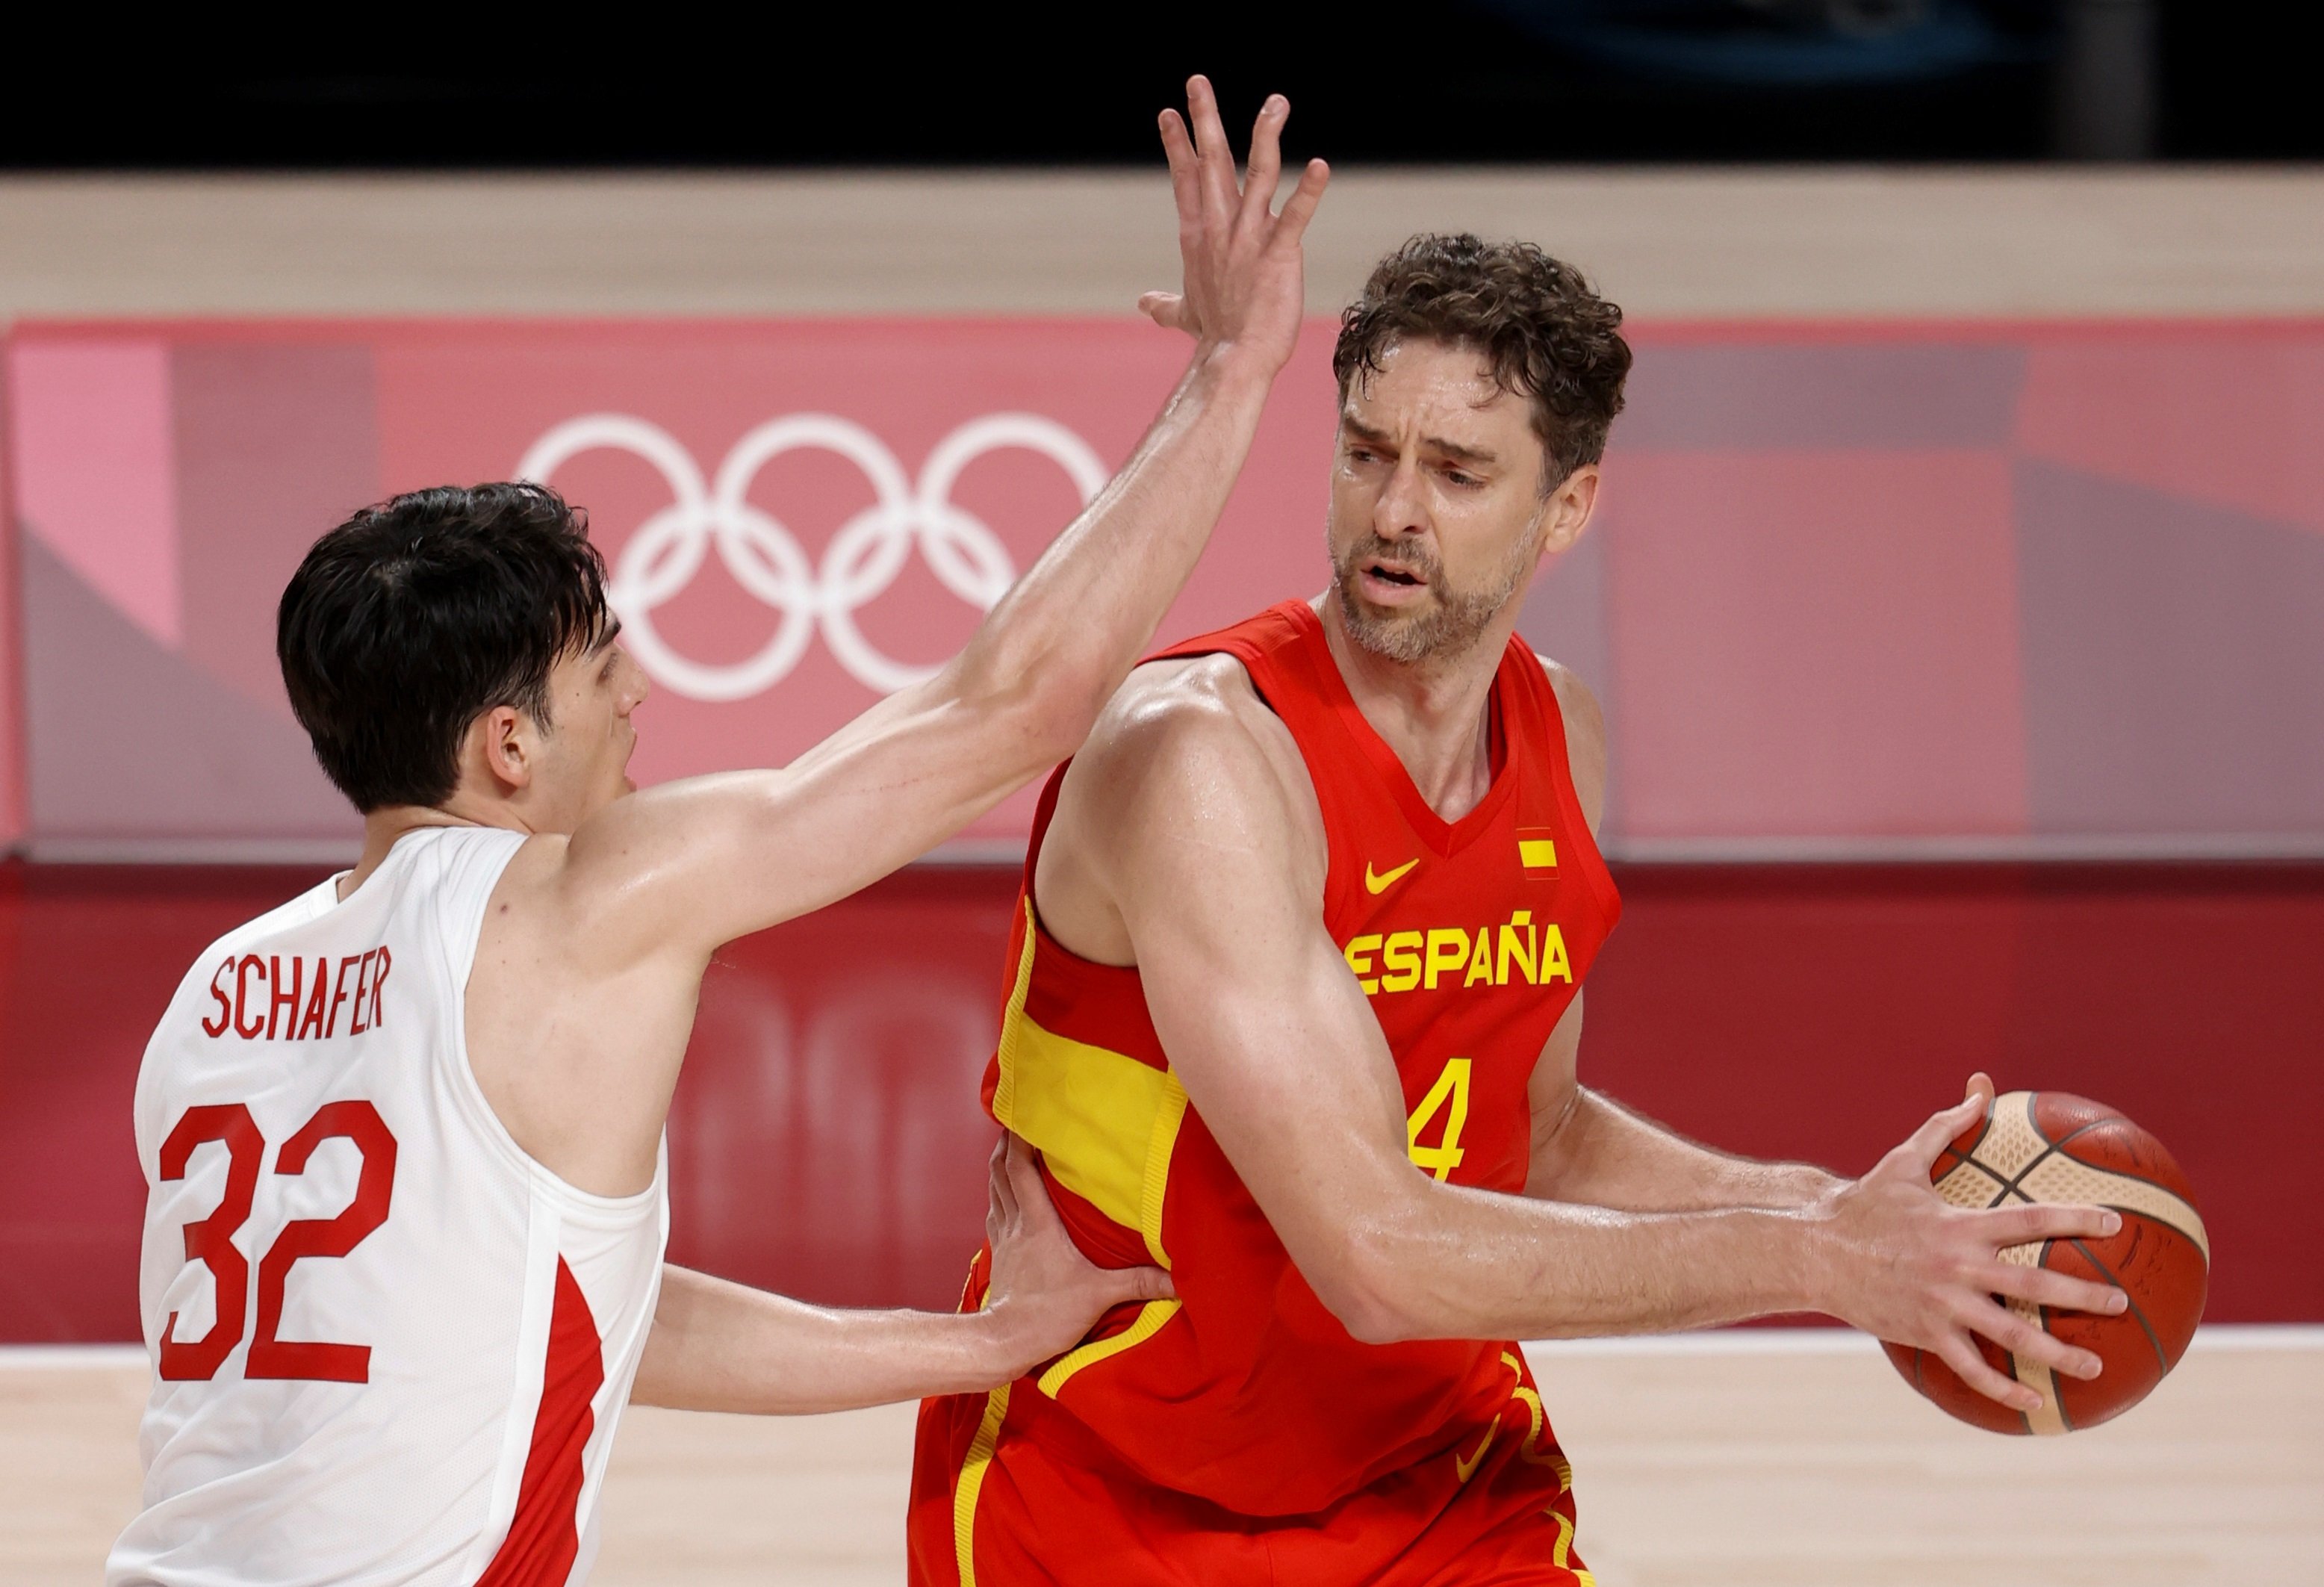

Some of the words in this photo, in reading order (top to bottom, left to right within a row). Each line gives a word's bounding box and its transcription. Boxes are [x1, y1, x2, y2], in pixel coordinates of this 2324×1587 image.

[202, 945, 391, 1040] SCHAFER
[1344, 910, 1573, 996] ESPAÑA
[1407, 1058, 1472, 1182] 4
[159, 1100, 397, 1383] 32
